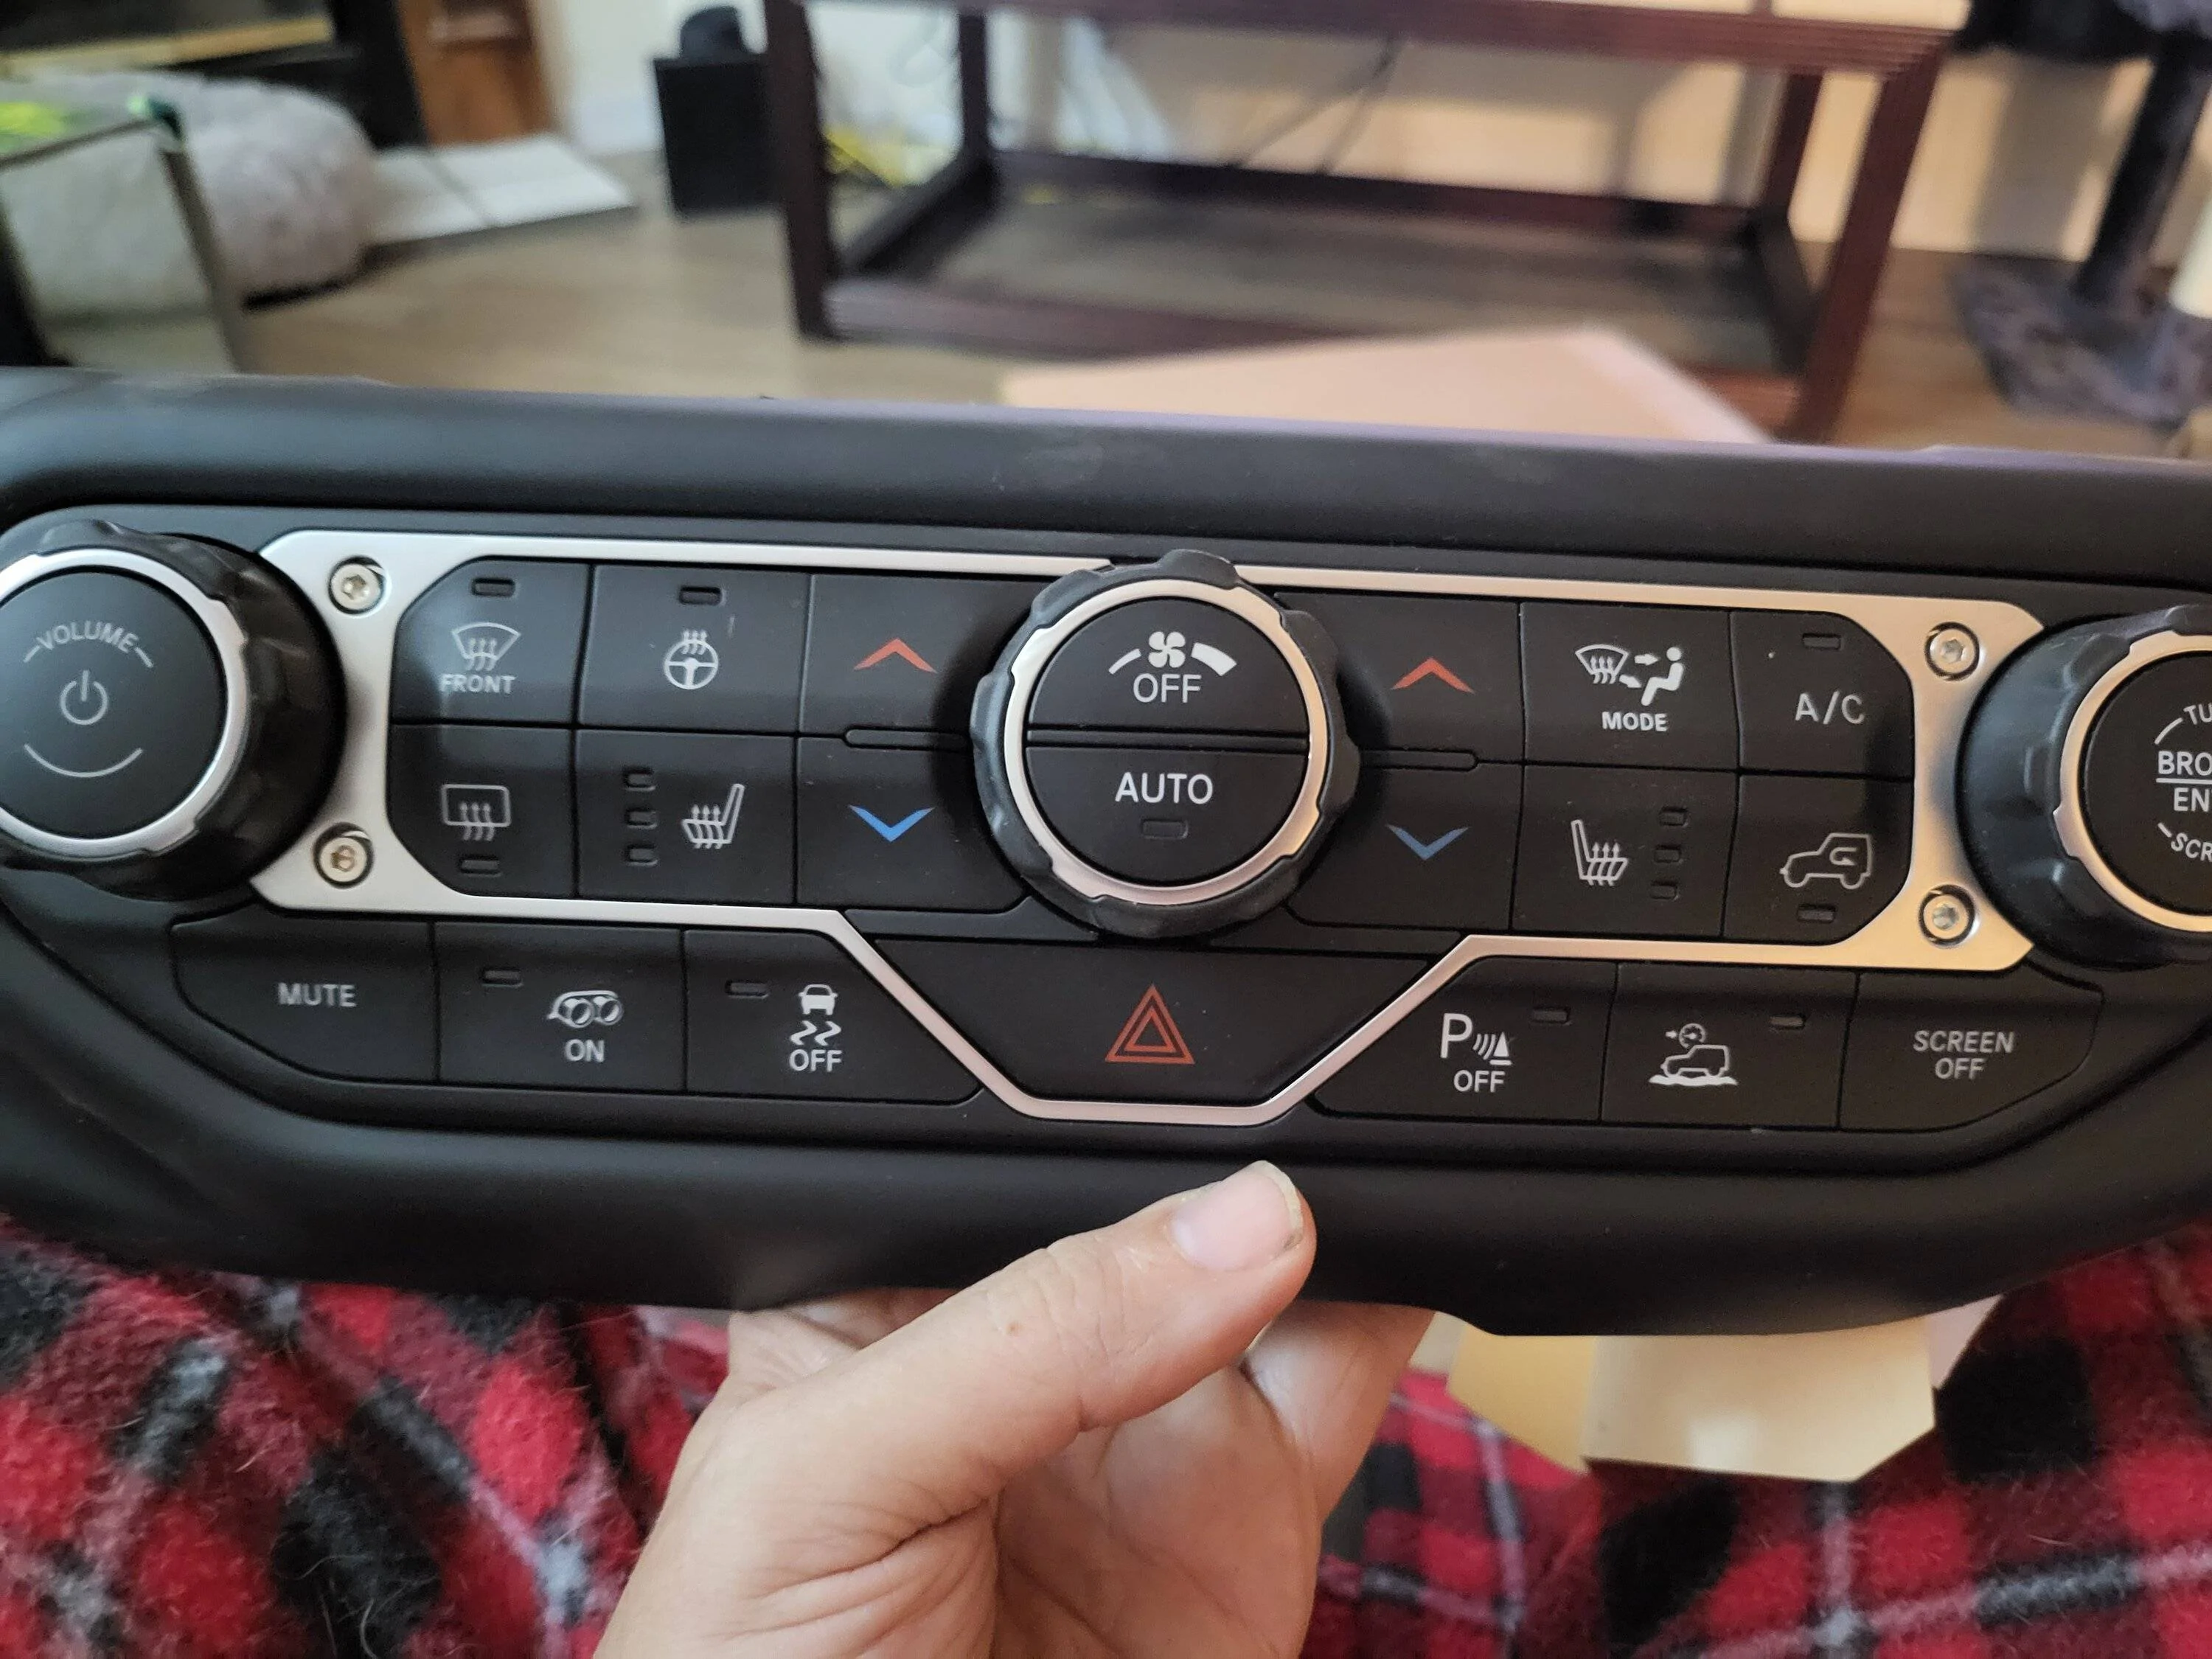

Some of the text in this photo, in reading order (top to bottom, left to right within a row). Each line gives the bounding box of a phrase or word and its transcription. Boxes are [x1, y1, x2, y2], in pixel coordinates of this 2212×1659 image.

[36, 621, 139, 653] VOLUME
[439, 673, 517, 694] FRONT
[1133, 672, 1203, 703] OFF
[1795, 690, 1865, 725] A/C
[1601, 711, 1669, 732] MODE
[1114, 771, 1214, 804] AUTO
[2174, 787, 2212, 813] EN
[278, 982, 357, 1007] MUTE
[1439, 1012, 1473, 1059] P
[1913, 1030, 2014, 1054] SCREEN
[564, 1038, 605, 1062] ON
[789, 1048, 843, 1072] OFF
[1935, 1057, 1986, 1079] OFF
[1453, 1069, 1506, 1093] OFF
